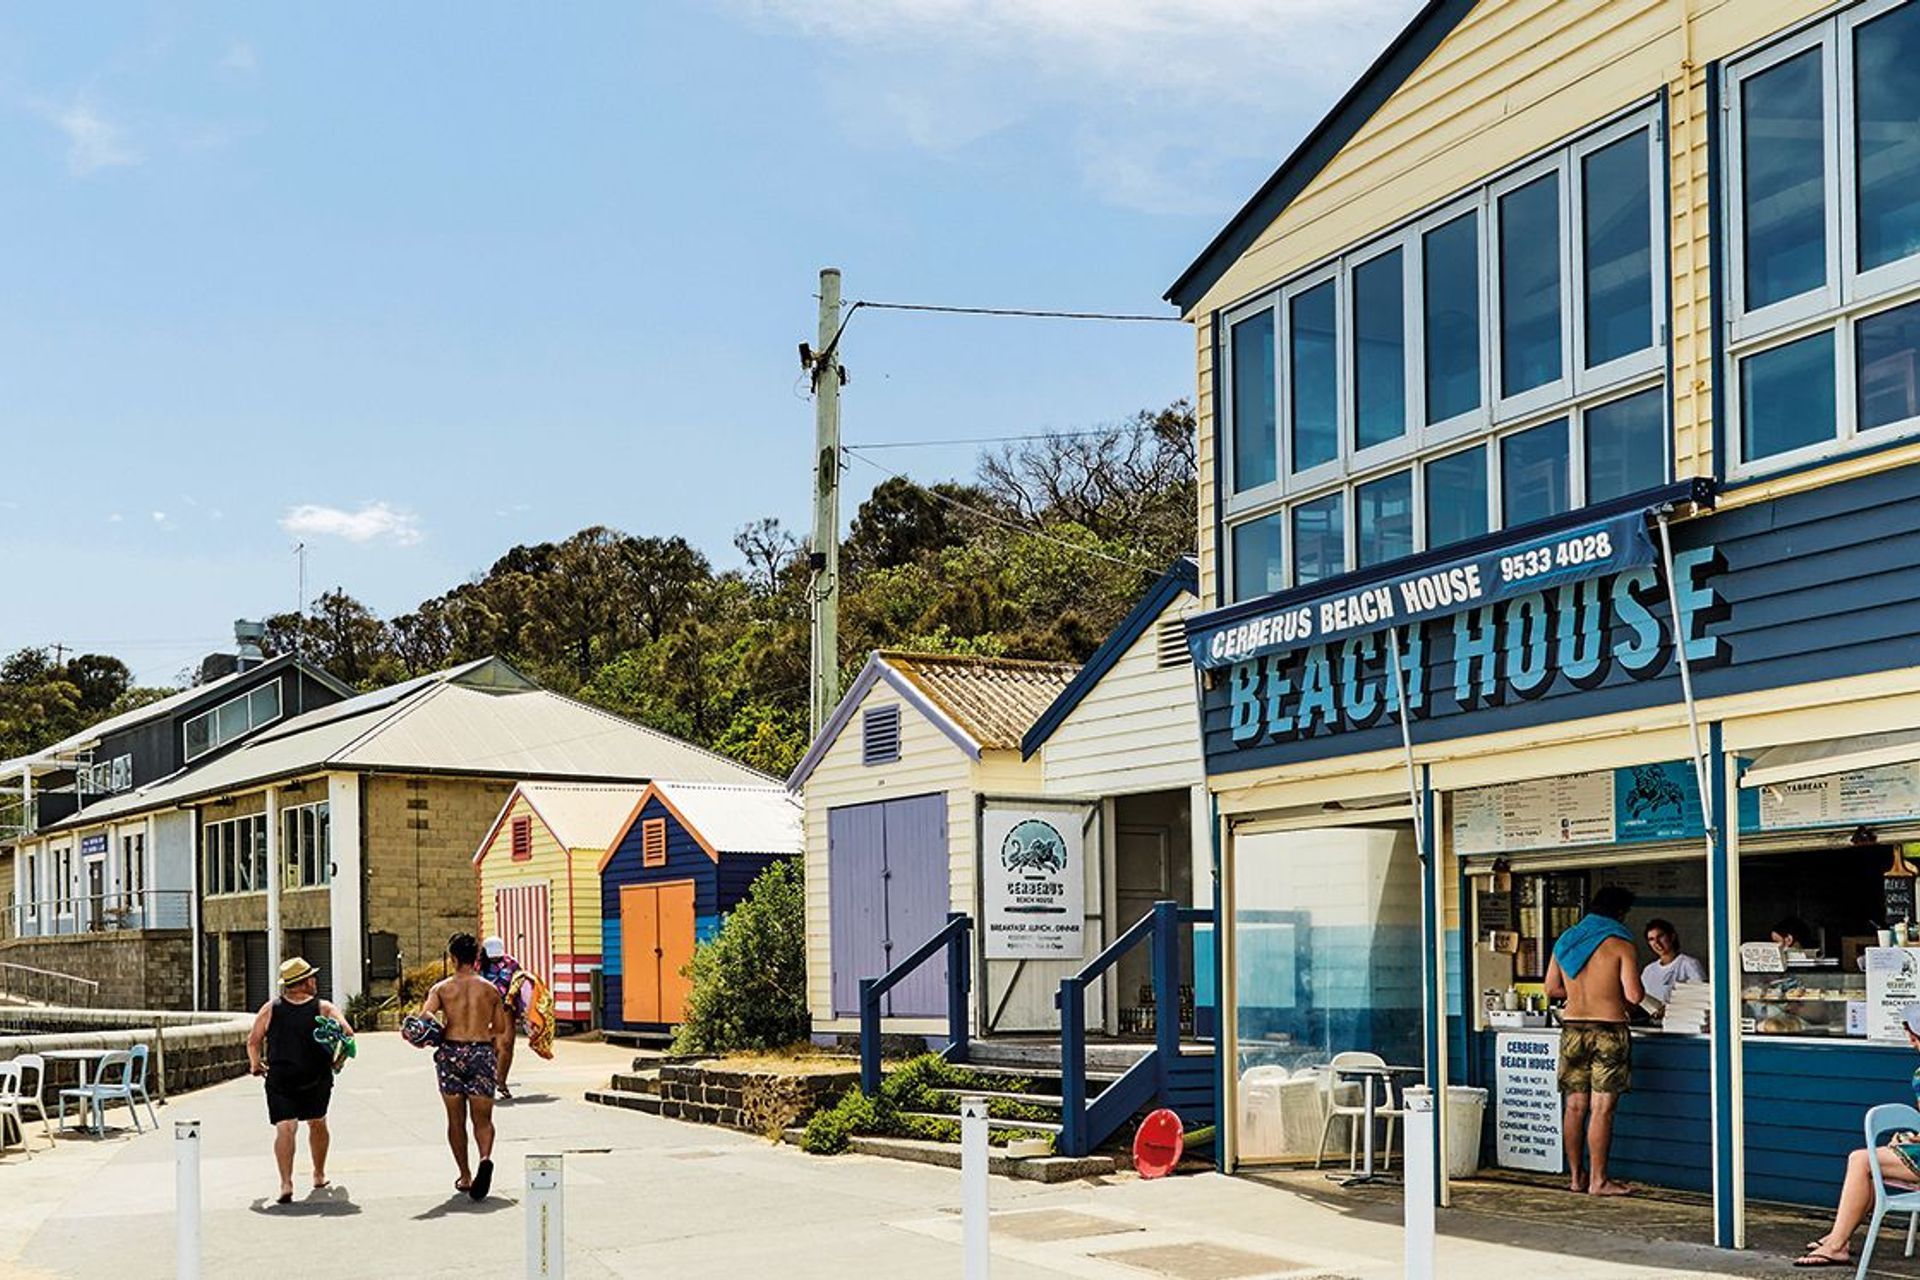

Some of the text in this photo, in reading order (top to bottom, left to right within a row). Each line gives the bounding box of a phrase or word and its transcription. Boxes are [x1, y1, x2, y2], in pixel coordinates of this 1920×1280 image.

[1211, 531, 1613, 659] CERBERUS BEACH HOUSE 9533 4028
[1230, 545, 1722, 743] BEACH HOUSE
[1007, 882, 1064, 896] CERBERUS
[1507, 1042, 1549, 1054] CERBERUS
[1501, 1056, 1556, 1071] BEACH HOUSE
[1509, 1075, 1521, 1083] THIS
[1523, 1076, 1529, 1084] IS
[1530, 1076, 1542, 1085] NOT
[1505, 1087, 1534, 1096] LICENSED
[1502, 1098, 1557, 1110] PATRONS ARE NOT
[1507, 1111, 1551, 1121] PERMITTED TO
[1499, 1121, 1559, 1134] CONSUME ALCOHOL
[1503, 1133, 1556, 1146] AT THESE TABLES
[1509, 1146, 1547, 1157] AT ANY TIME
